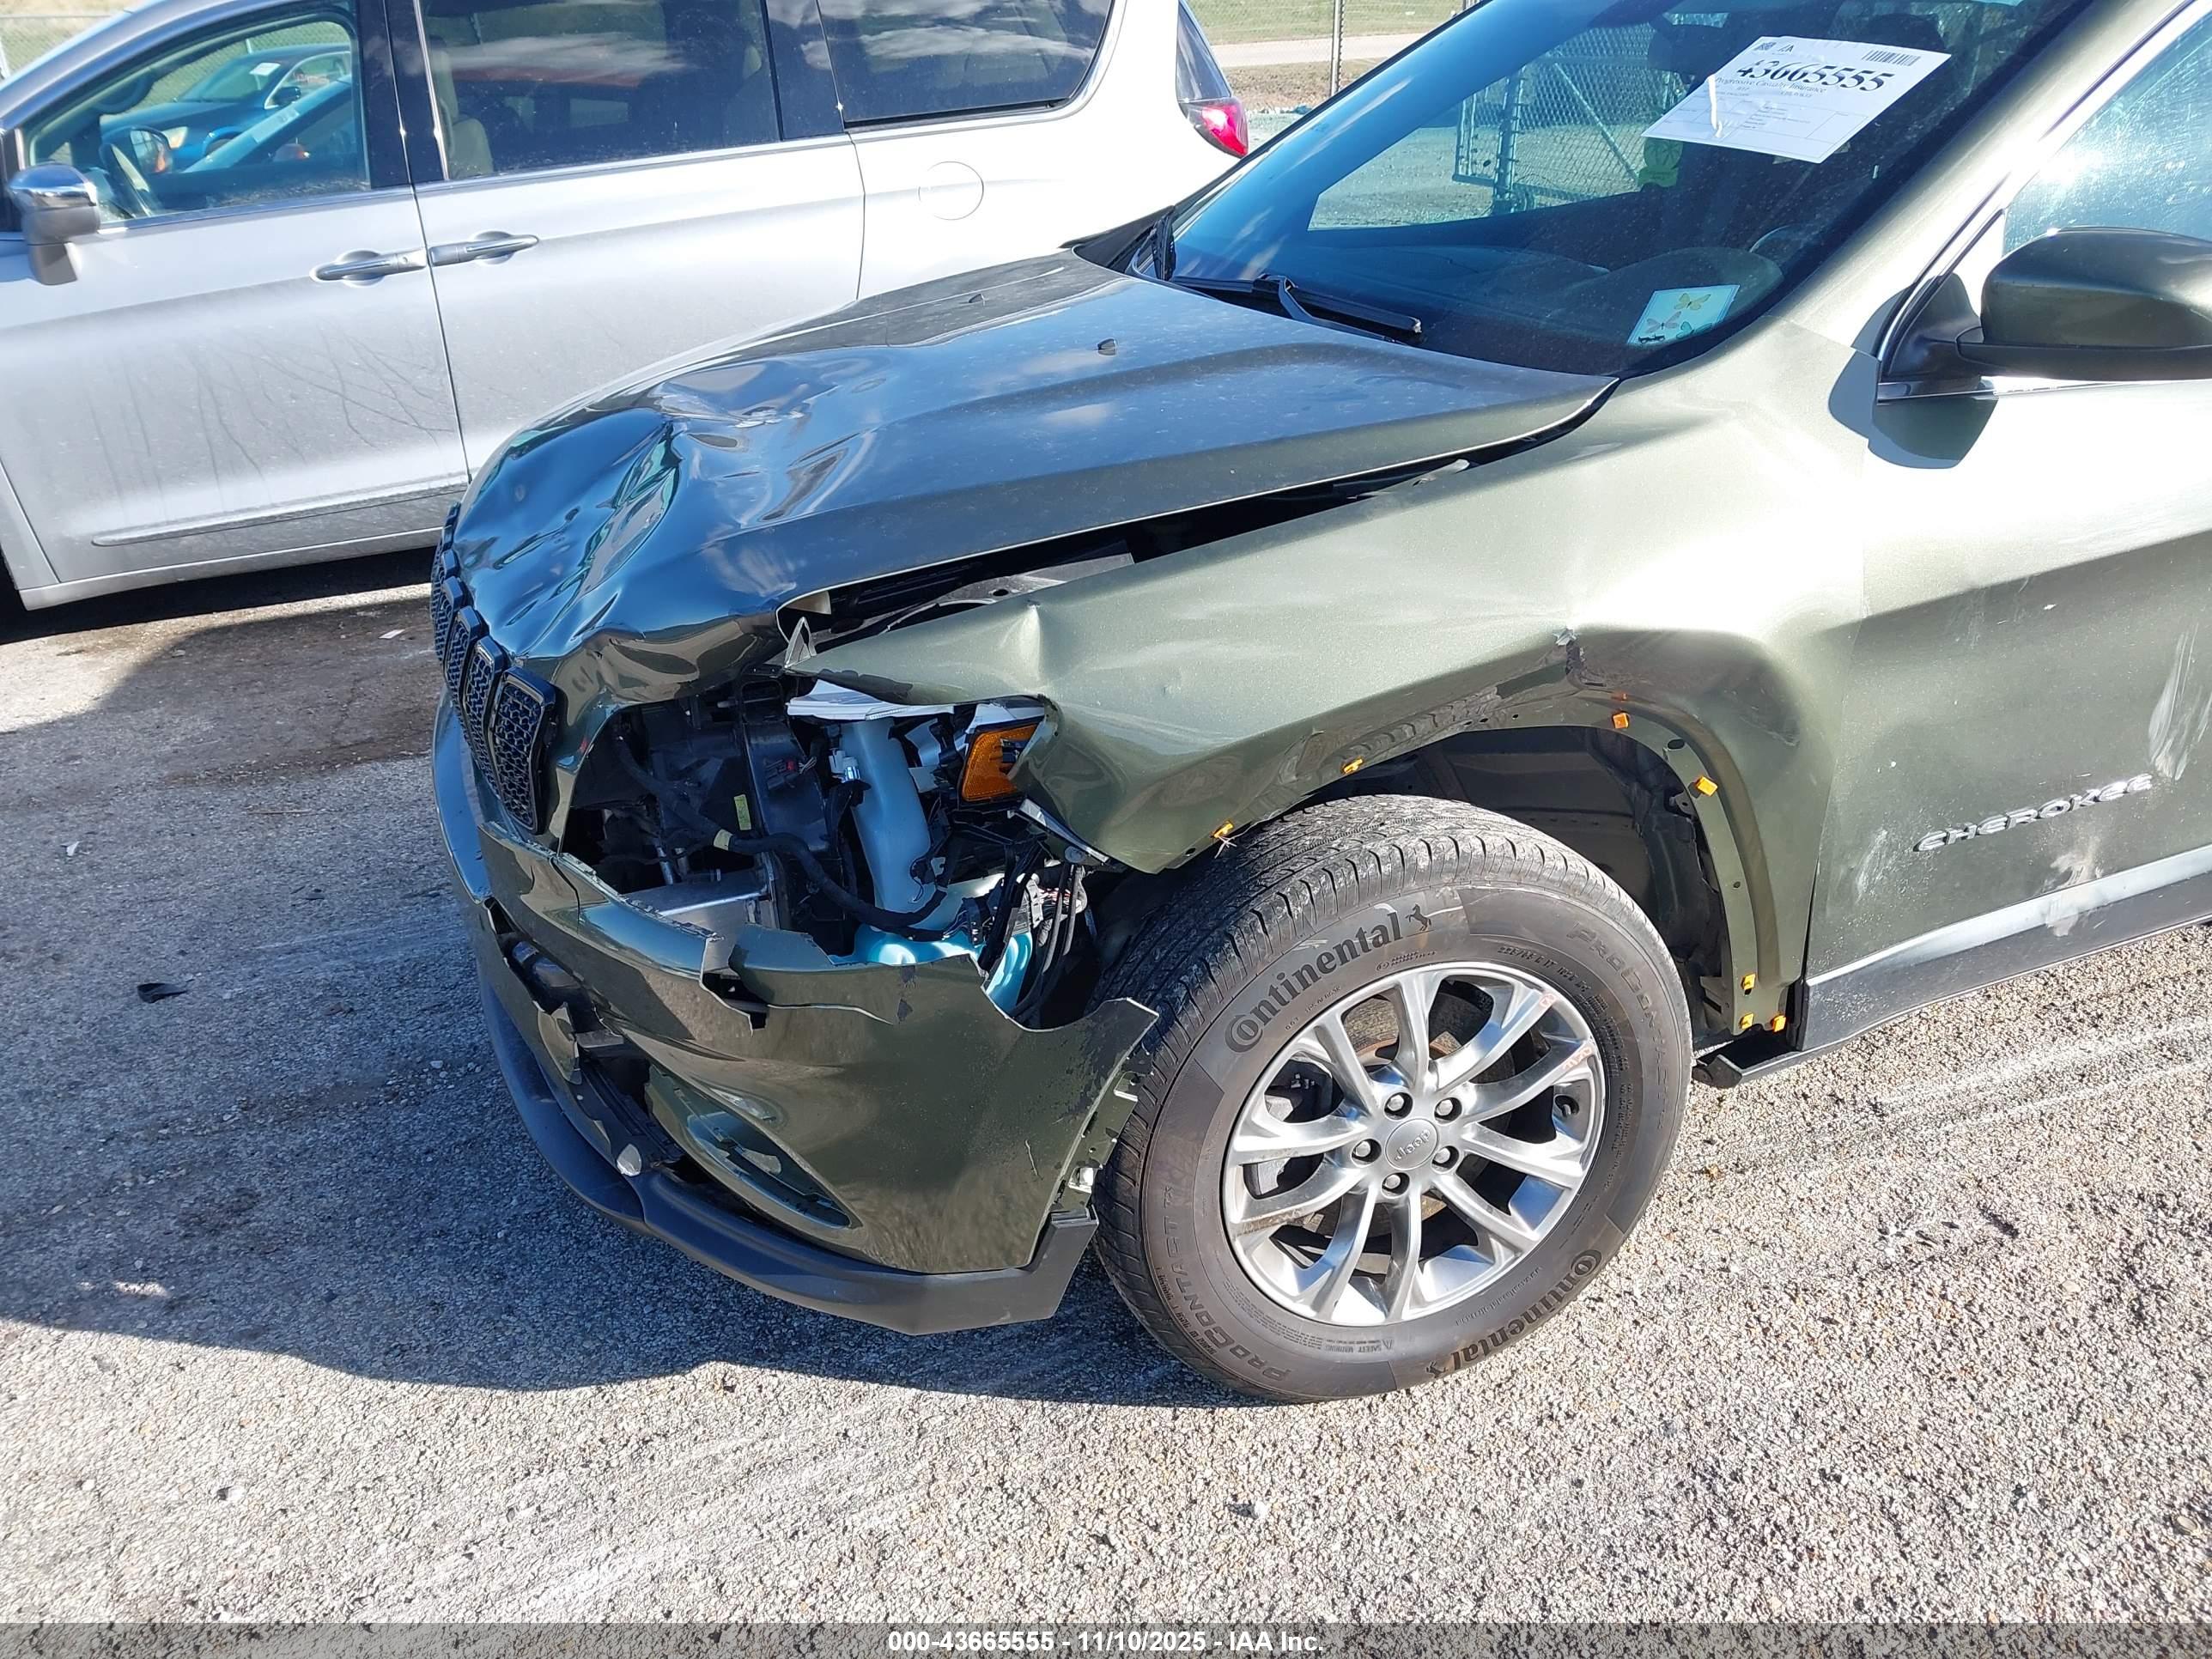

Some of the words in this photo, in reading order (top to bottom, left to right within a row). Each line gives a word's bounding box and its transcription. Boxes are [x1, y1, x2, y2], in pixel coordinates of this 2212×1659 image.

[1715, 77, 1755, 86] Progressive
[1756, 81, 1789, 89] Casualty
[1789, 82, 1826, 94] Insurance
[1736, 59, 1895, 91] 43665555
[1913, 773, 2152, 852] CHEROKEE
[1225, 912, 1403, 1053] Continental
[1395, 1129, 1431, 1162] Jeep
[1164, 1215, 1293, 1382] PROCONTACT
[1450, 1249, 1603, 1370] Continental
